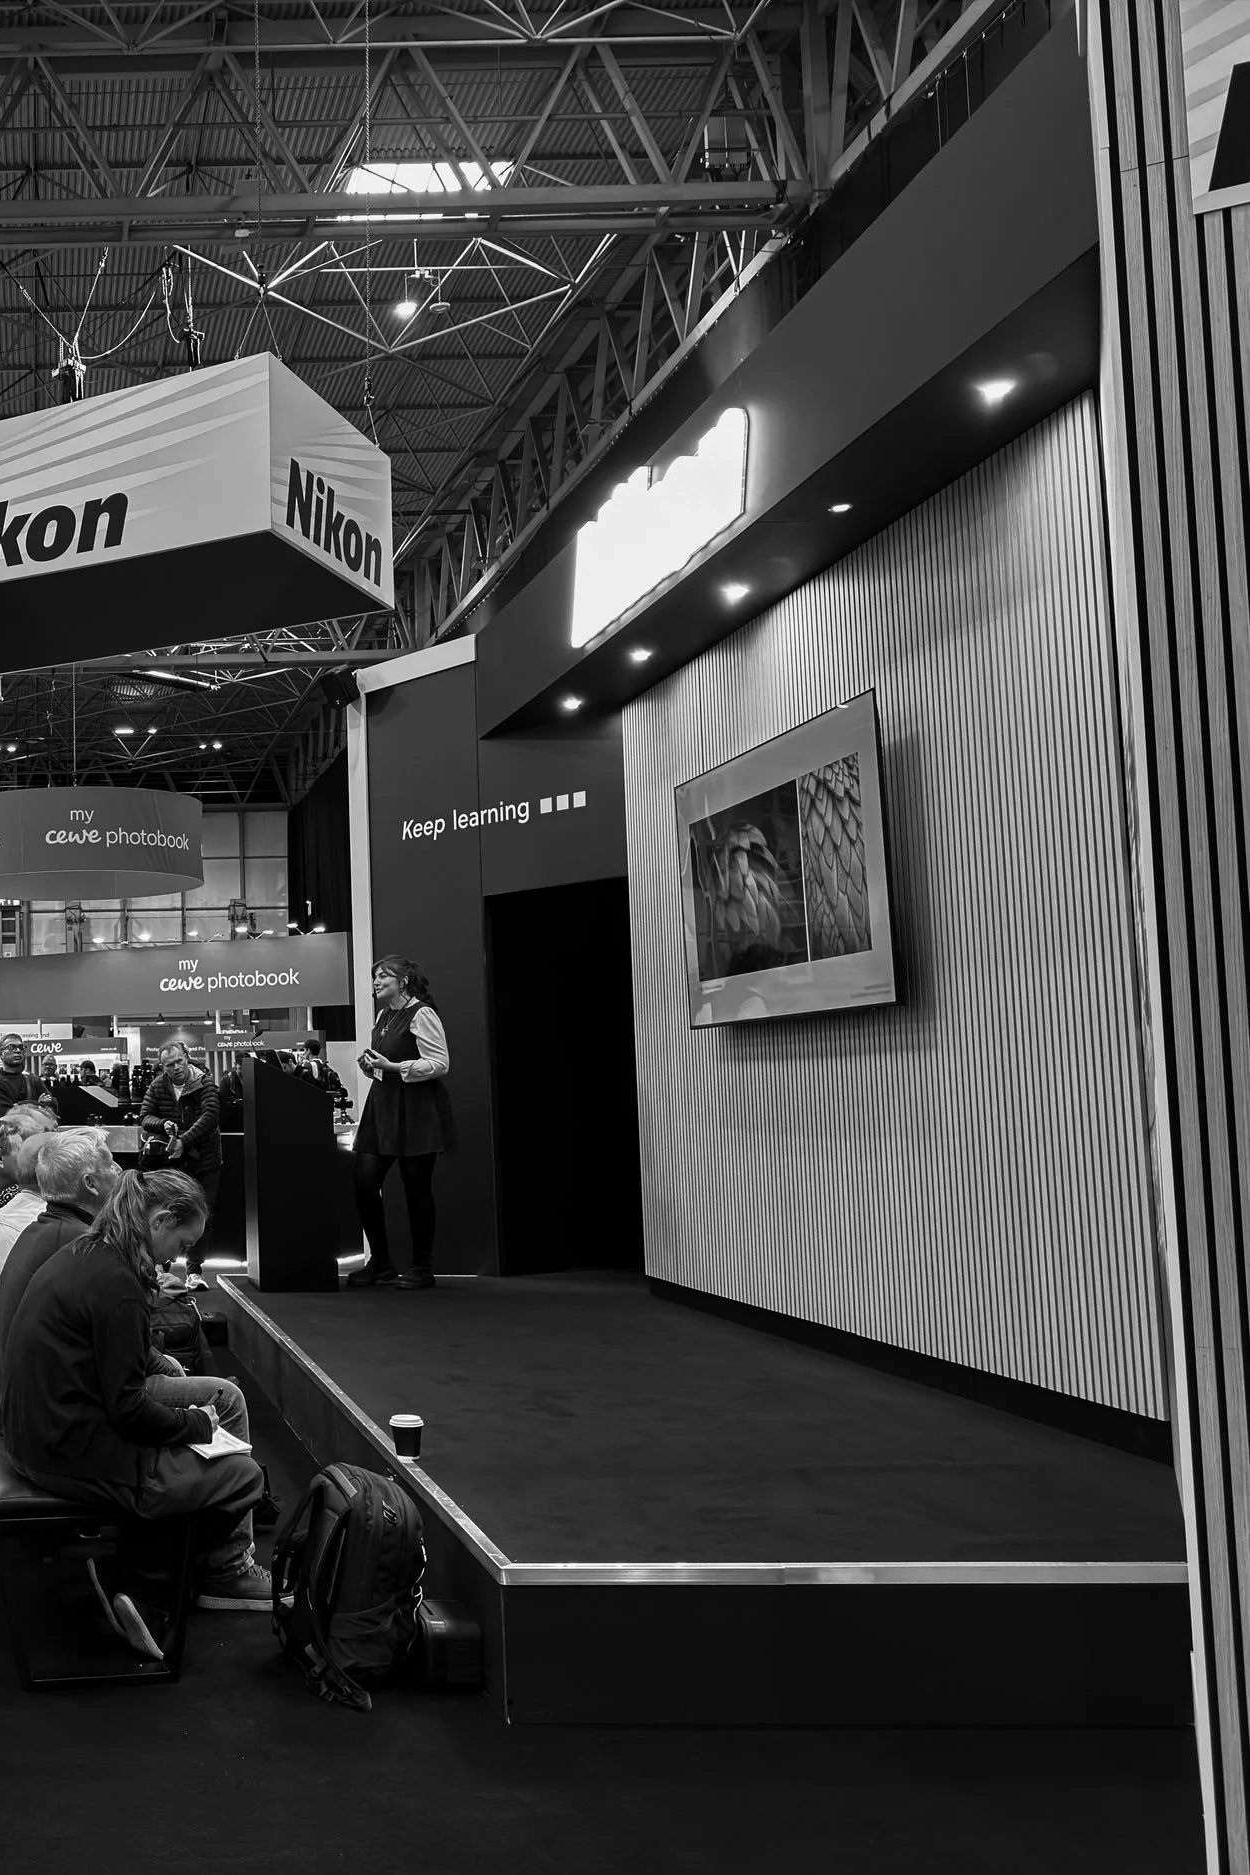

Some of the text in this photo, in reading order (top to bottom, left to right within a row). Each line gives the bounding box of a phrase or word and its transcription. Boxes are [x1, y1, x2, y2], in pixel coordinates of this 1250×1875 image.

[286, 458, 384, 587] Nikon
[70, 809, 94, 824] my
[402, 801, 530, 840] Keep learning
[45, 827, 190, 850] cewe photobook
[178, 959, 199, 973] my
[159, 968, 300, 993] cewe photobook
[31, 1042, 63, 1053] cewe
